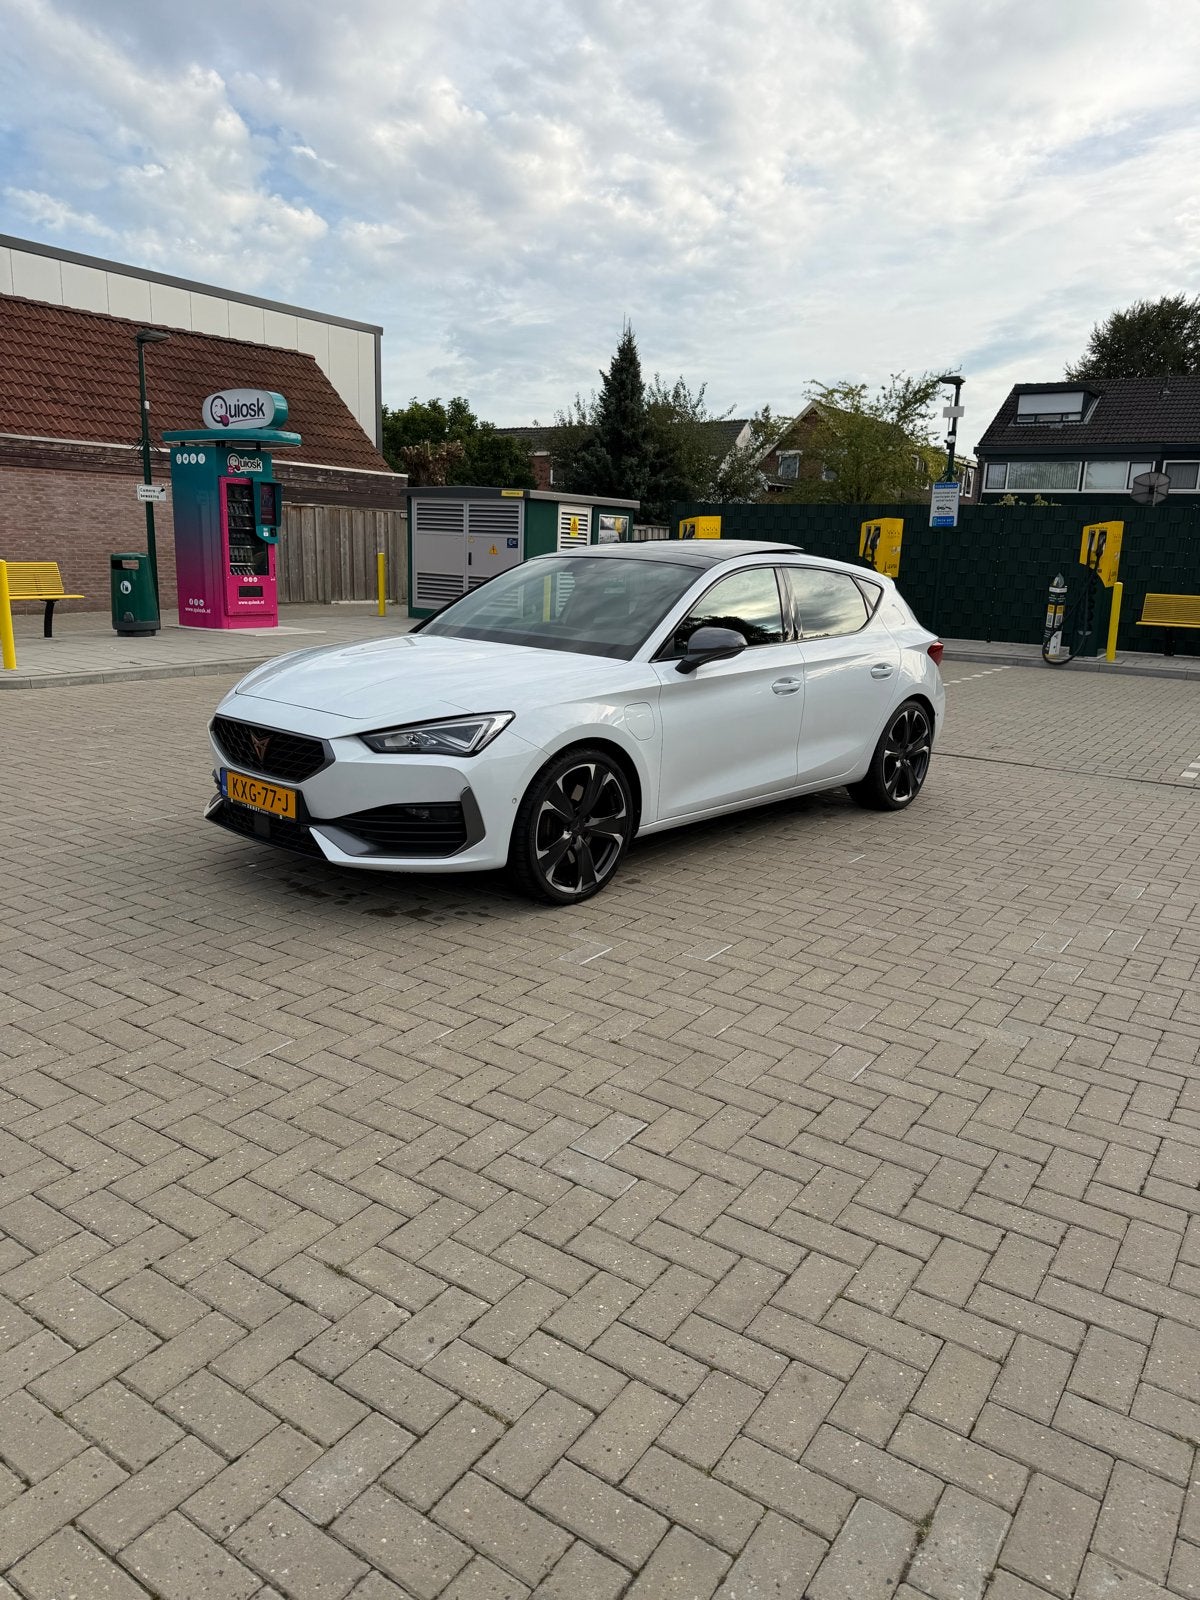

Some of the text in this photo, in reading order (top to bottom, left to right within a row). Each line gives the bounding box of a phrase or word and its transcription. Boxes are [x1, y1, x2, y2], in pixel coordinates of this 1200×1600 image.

[210, 396, 265, 427] Quiosk
[228, 454, 262, 472] Quiosk
[232, 777, 289, 812] KXG-77-J
